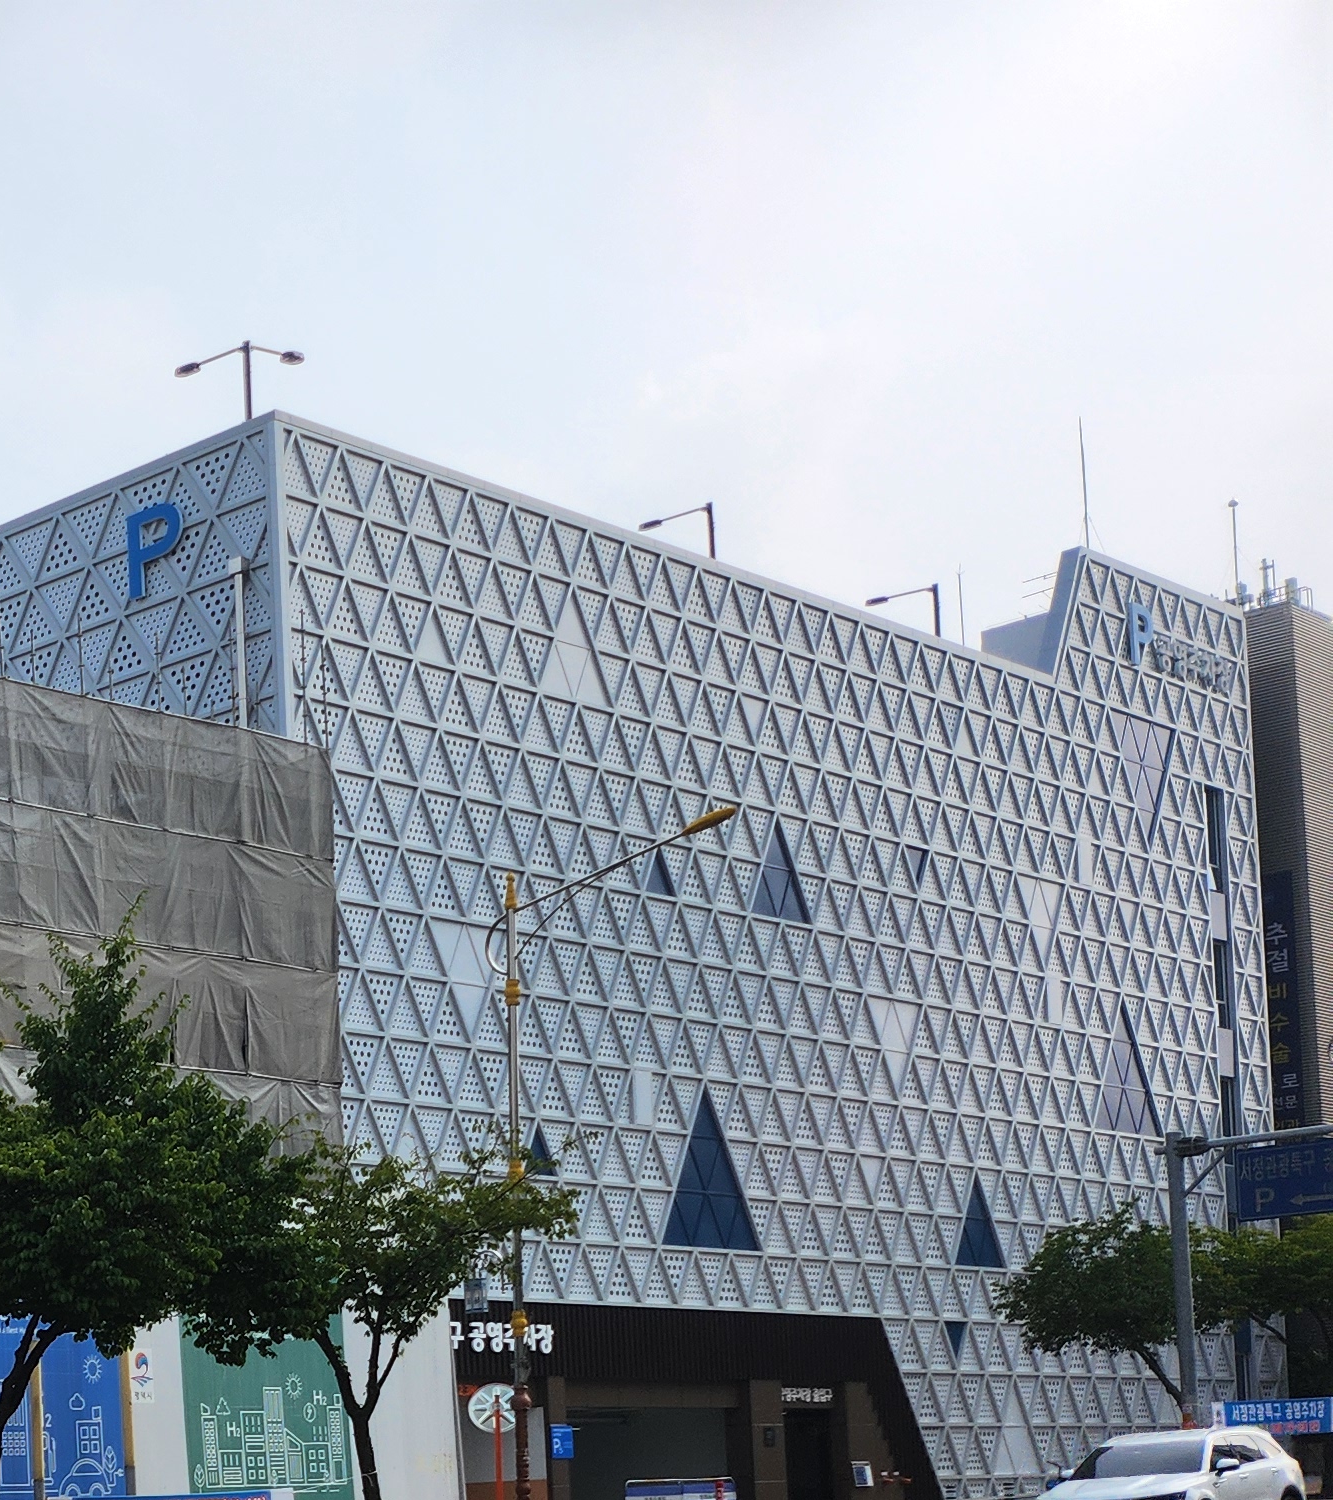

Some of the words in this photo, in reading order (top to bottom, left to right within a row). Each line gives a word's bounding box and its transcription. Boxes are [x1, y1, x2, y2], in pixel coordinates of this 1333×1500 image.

[125, 502, 183, 599] P
[1126, 602, 1154, 667] P
[1255, 1187, 1275, 1213] P
